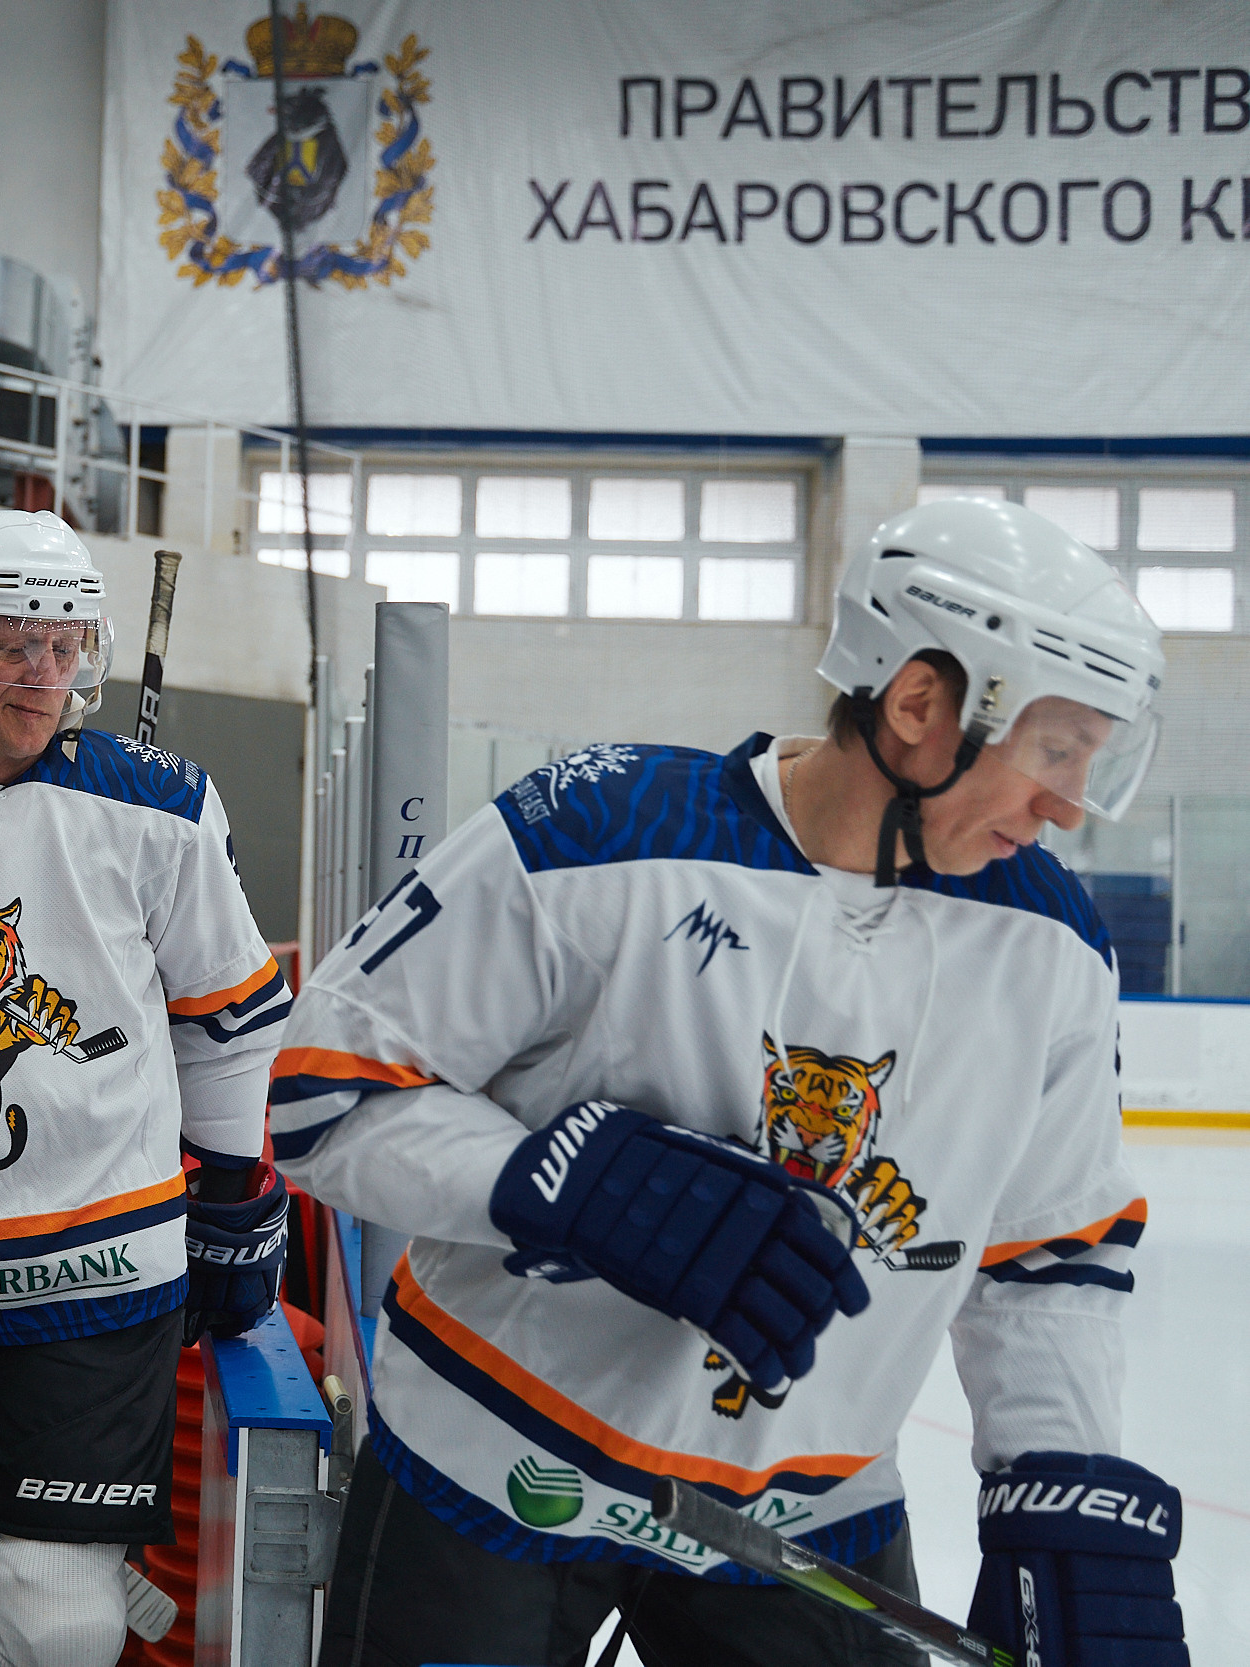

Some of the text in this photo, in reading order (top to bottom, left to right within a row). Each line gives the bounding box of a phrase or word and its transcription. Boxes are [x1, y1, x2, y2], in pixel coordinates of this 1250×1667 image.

[525, 176, 1250, 245] ХАБАРОВСКОГО К
[24, 577, 79, 589] BAUER
[905, 584, 978, 618] BAUER
[15, 1477, 158, 1506] BAUER
